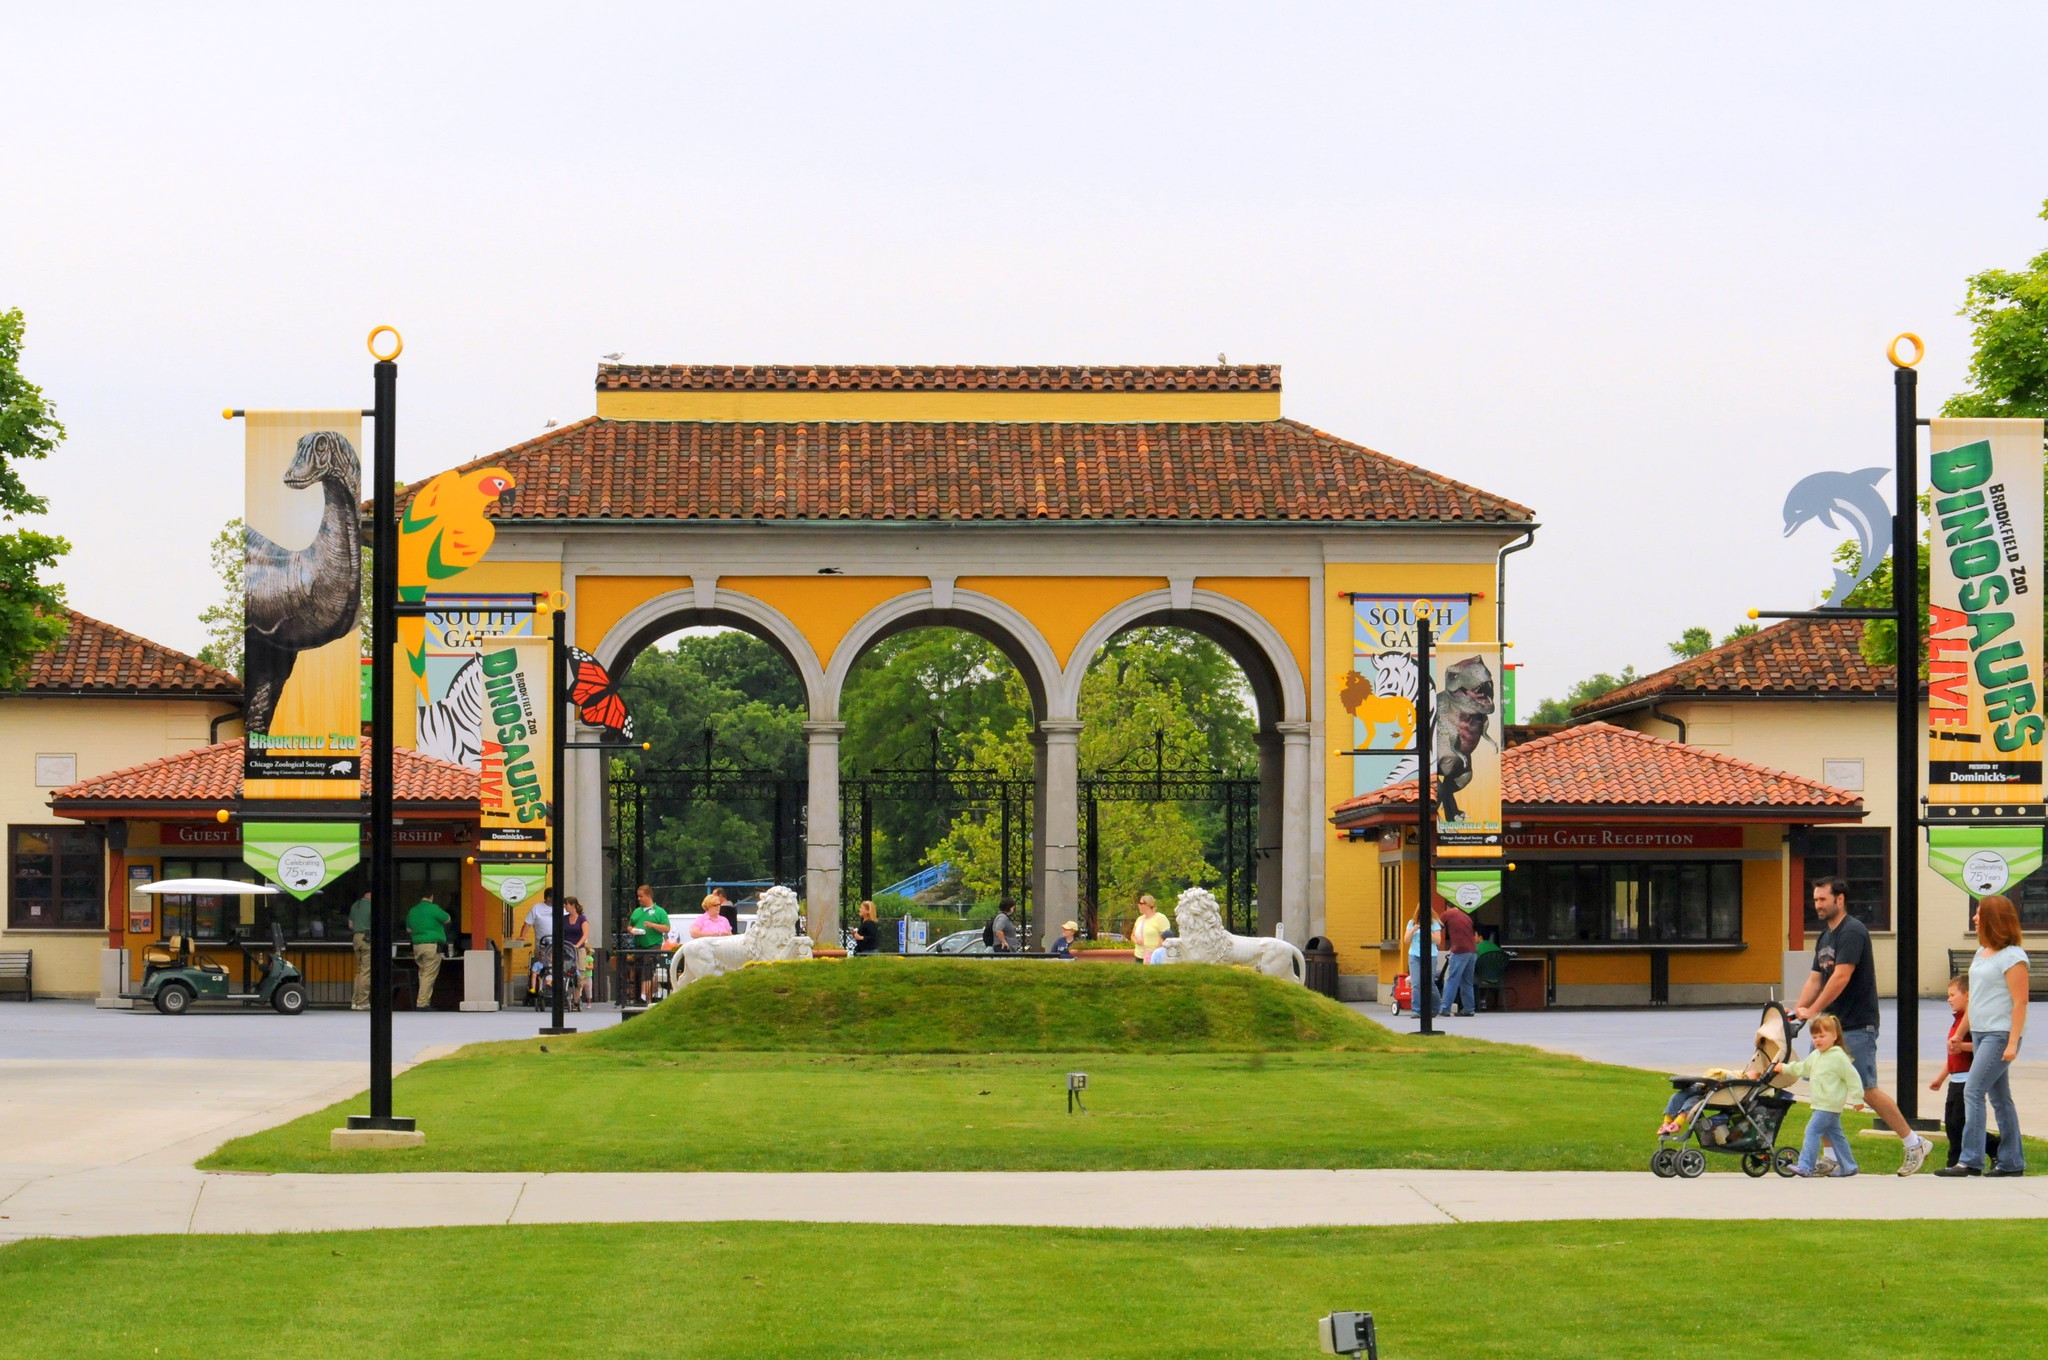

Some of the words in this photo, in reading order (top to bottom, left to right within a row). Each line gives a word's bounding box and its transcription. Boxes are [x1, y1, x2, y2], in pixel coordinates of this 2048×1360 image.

[1989, 483, 2020, 563] BROOKFIELD
[2010, 565, 2028, 595] ZOO
[1931, 440, 2044, 752] DINOSAURS
[1929, 604, 1981, 743] ALIVE!
[515, 672, 533, 717] BROOKFIELD
[527, 719, 538, 735] ZOO
[249, 732, 325, 750] BROOKFIELD
[329, 733, 357, 750] ZOO
[482, 647, 546, 823] DINOSAURS
[249, 761, 274, 770] Chicago
[275, 760, 305, 770] Zoological
[306, 760, 327, 769] Society
[480, 740, 510, 818] ALIVE!
[1950, 772, 2007, 782] Dominick's
[179, 826, 230, 841] GUEST
[1501, 833, 1549, 845] OUTH
[1553, 830, 1597, 845] GATE
[1602, 830, 1694, 845] RECEPTION
[284, 859, 320, 867] Celebrating
[284, 867, 299, 878] 75
[301, 868, 318, 876] Years
[1970, 871, 1983, 882] 75
